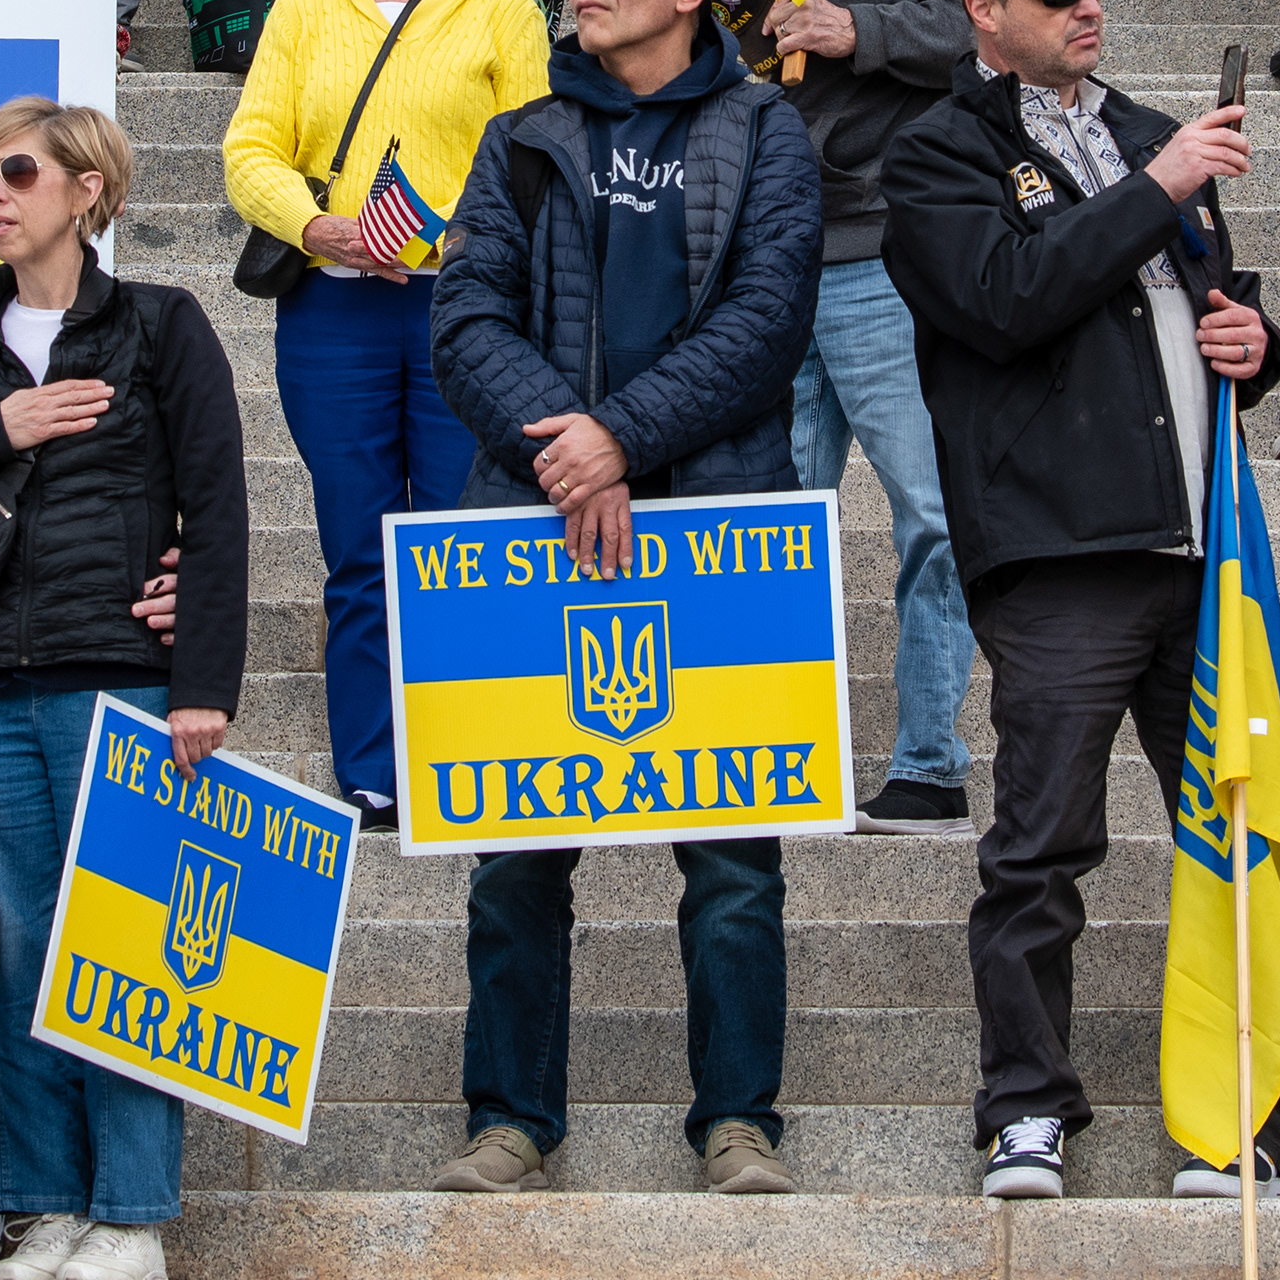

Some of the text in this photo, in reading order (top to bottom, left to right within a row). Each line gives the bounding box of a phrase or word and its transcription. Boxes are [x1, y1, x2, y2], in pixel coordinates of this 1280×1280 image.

[1020, 190, 1055, 213] WHW
[410, 518, 815, 591] WE STD WITH
[105, 731, 151, 795] WE
[262, 803, 341, 880] WITH
[428, 742, 822, 825] UKRAINE
[65, 951, 300, 1109] UKRAINE
